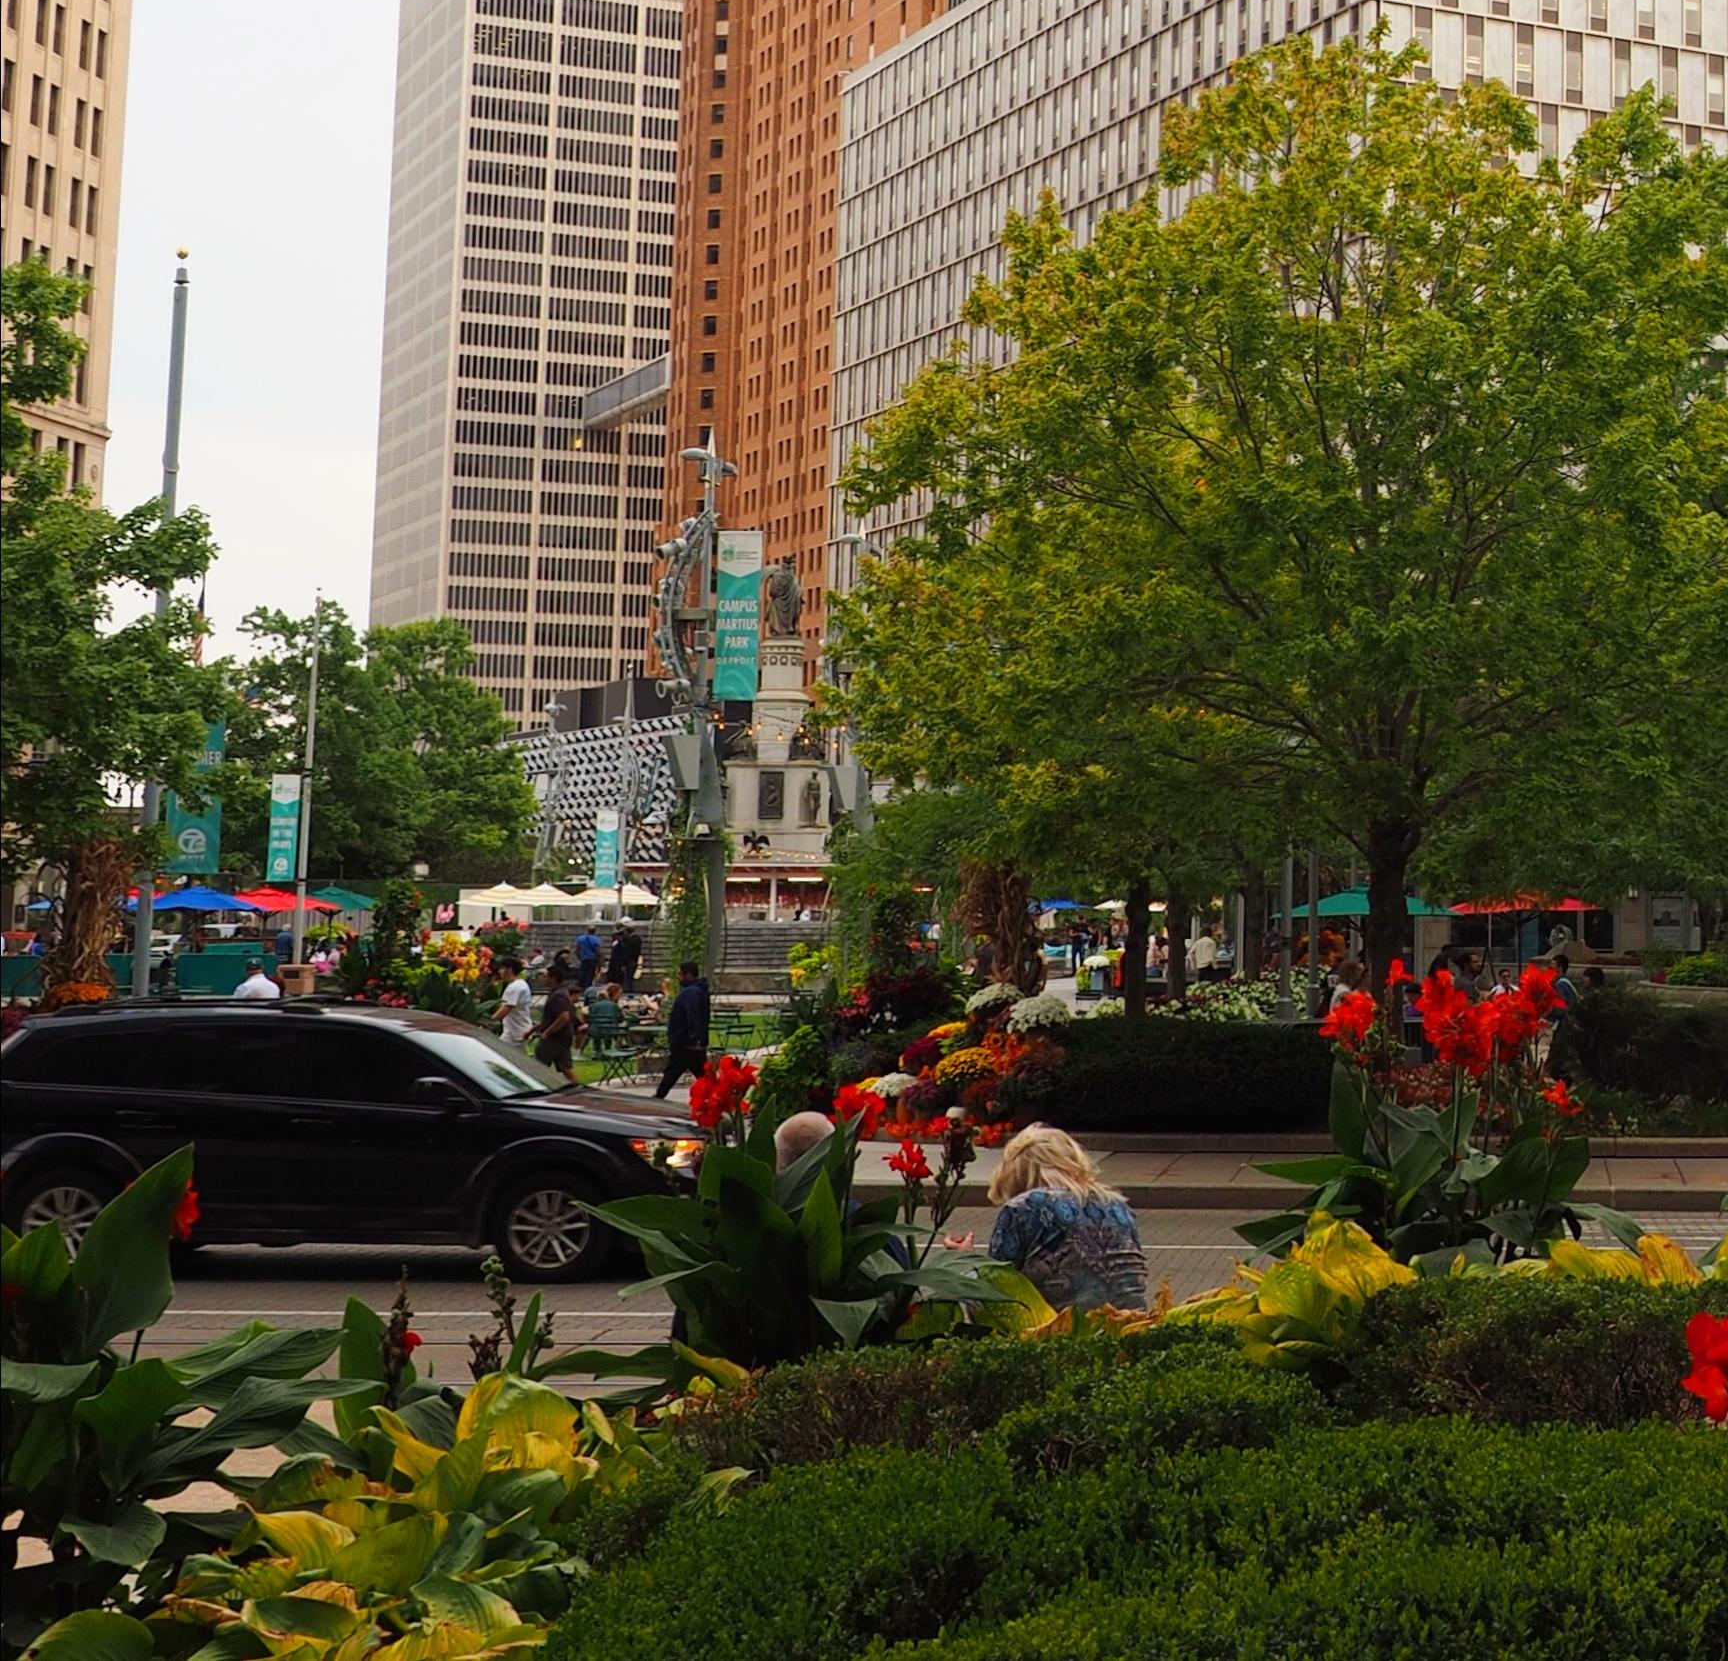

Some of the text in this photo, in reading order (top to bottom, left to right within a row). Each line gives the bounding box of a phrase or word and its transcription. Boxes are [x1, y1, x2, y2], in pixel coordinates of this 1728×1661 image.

[718, 600, 758, 612] CAMPUS
[716, 618, 758, 631] MARTIUS
[724, 636, 749, 649] PARK
